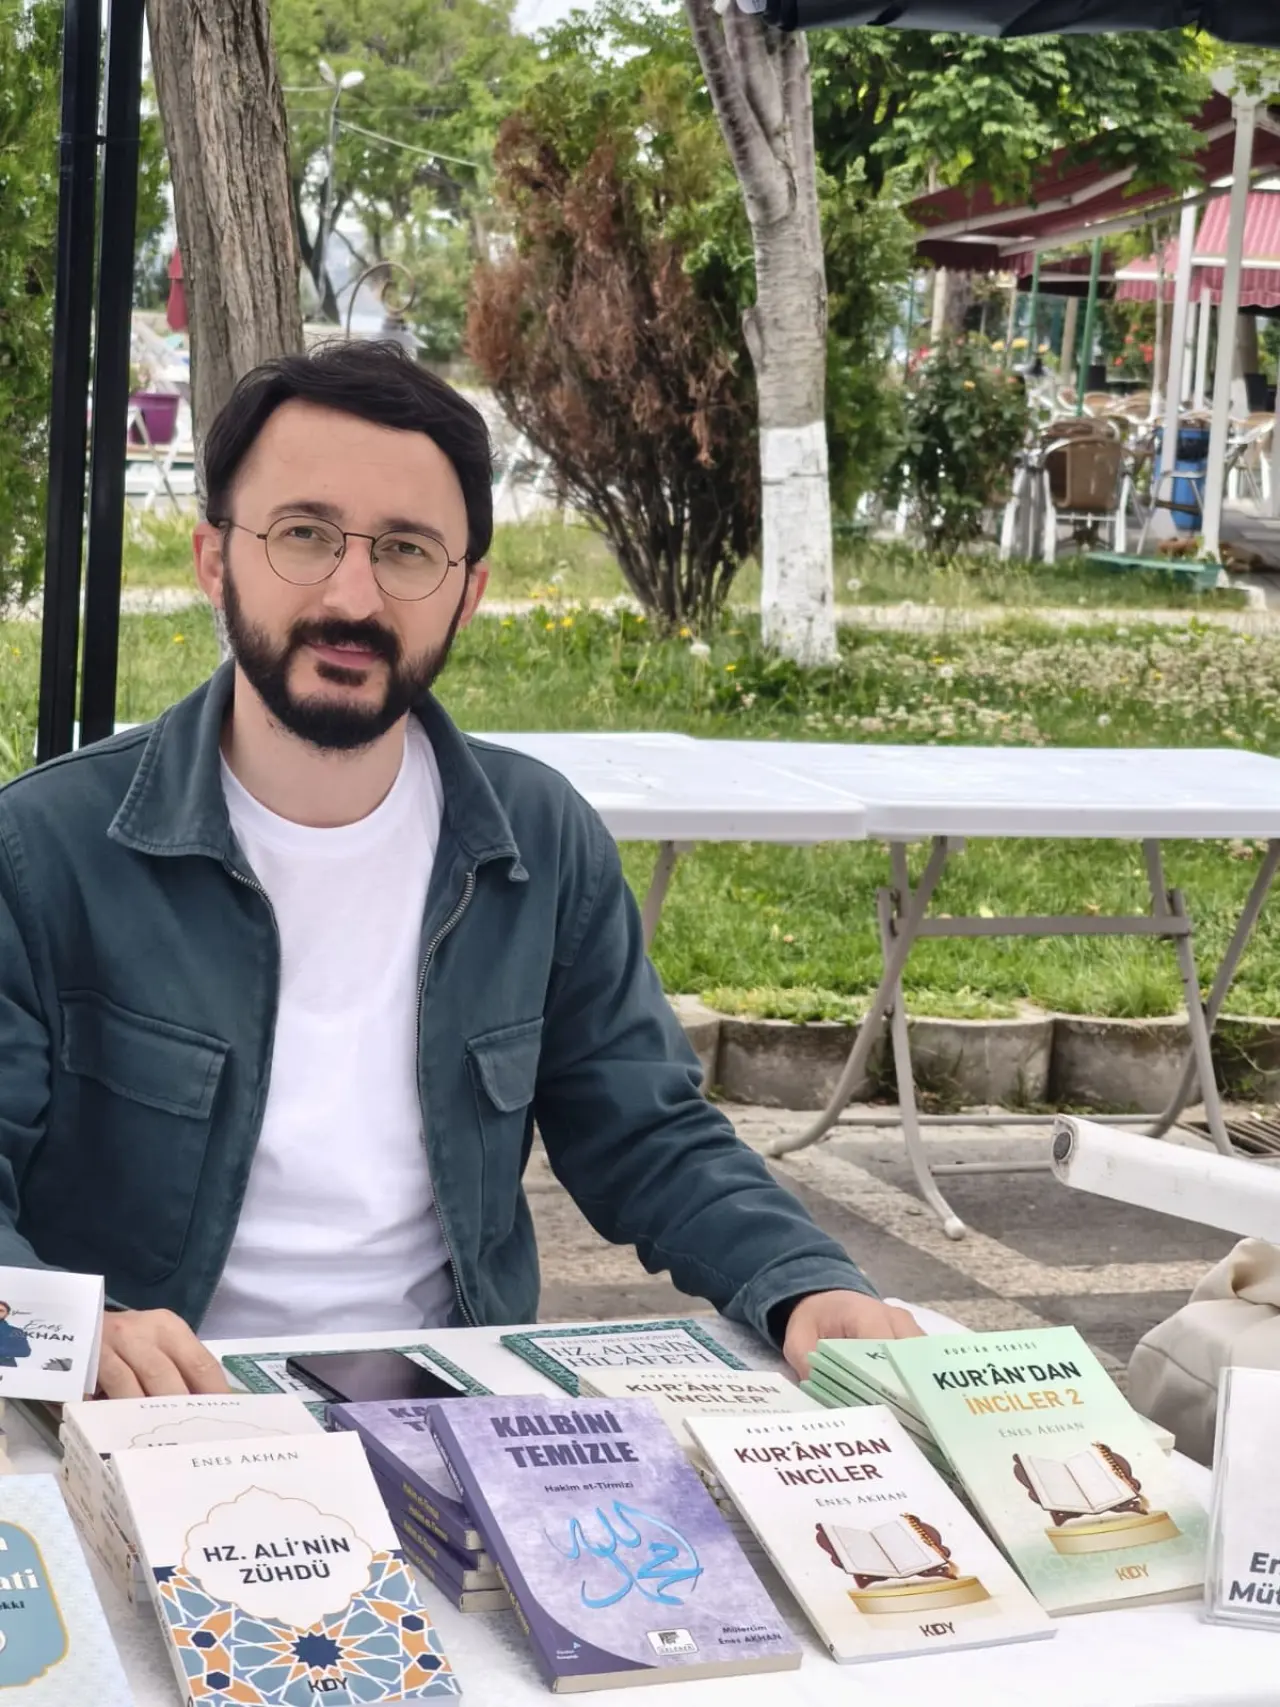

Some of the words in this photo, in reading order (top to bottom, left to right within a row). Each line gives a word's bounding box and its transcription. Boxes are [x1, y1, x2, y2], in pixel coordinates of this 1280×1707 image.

[626, 1381, 781, 1395] KUR'ÂN'DAN
[932, 1361, 1083, 1391] KUR'ÂN'DAN
[962, 1388, 1065, 1416] İNCİLER
[1066, 1388, 1085, 1406] 2
[490, 1409, 624, 1438] KALBİNİ
[504, 1440, 640, 1468] TEMİZLE
[734, 1437, 893, 1464] KUR'ÂN'DAN
[774, 1463, 884, 1486] İNCİLER
[856, 1490, 908, 1504] AKHAN
[203, 1545, 247, 1563] HZ.
[254, 1534, 351, 1560] ALİ'NİN
[239, 1559, 331, 1584] ZÜHDÜ
